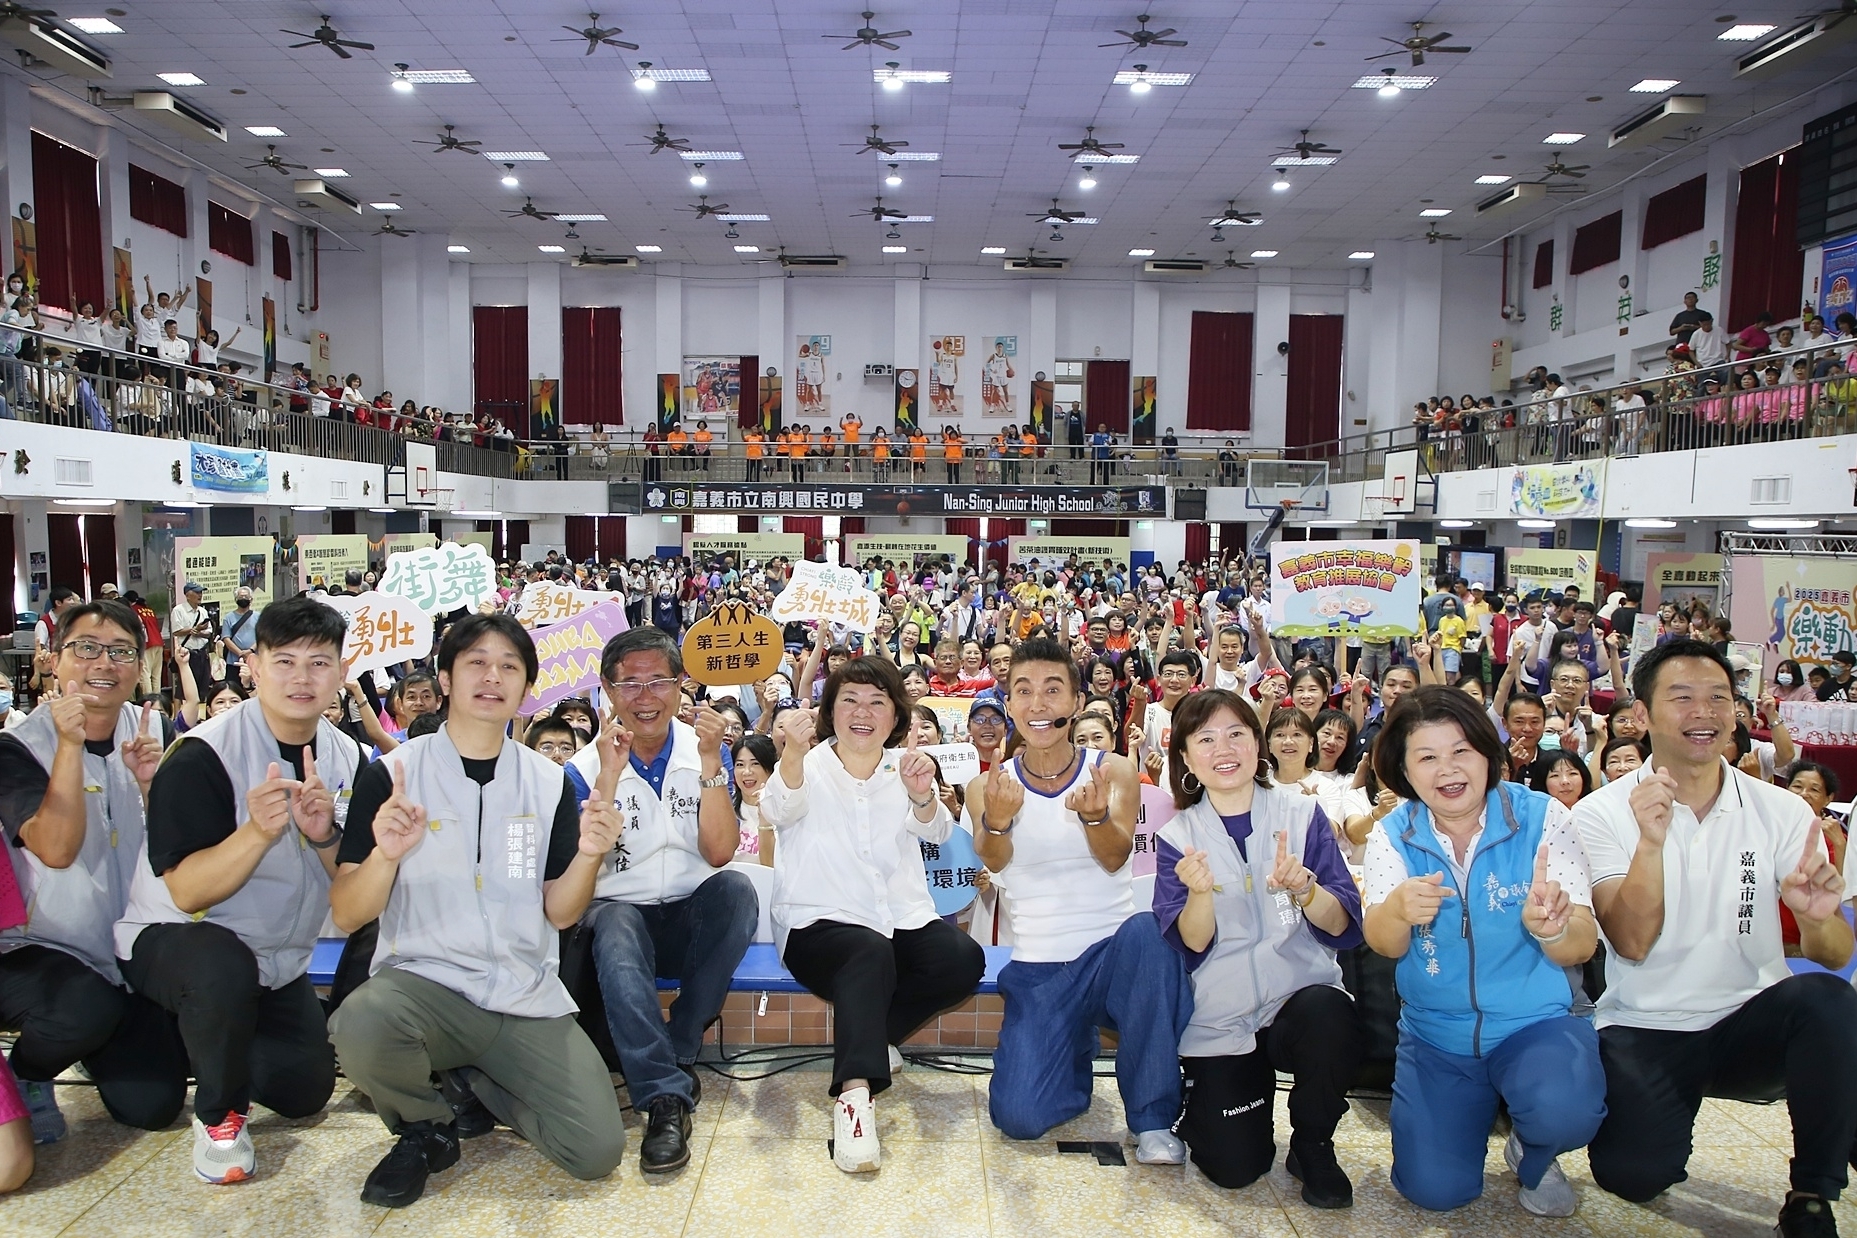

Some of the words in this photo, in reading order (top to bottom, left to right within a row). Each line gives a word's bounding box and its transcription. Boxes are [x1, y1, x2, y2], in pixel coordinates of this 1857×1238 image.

[1701, 254, 1721, 288] 聚
[692, 491, 863, 509] 嘉義市立南興國民中學
[995, 494, 1029, 511] Junior
[1031, 494, 1055, 514] High
[1058, 494, 1094, 512] School
[386, 550, 488, 610] 街舞
[1278, 550, 1413, 579] 嘉義市幸福樂齡
[1662, 570, 1720, 582] 全嘉動起來
[819, 568, 855, 595] 樂齡
[1294, 568, 1397, 593] 教育推展協會
[779, 582, 870, 626] 勇壯城
[346, 605, 415, 665] 勇壯
[536, 621, 605, 664] Danc
[697, 631, 769, 650] 第三人生
[706, 653, 760, 671] 新哲學
[626, 795, 640, 831] 議員
[507, 823, 524, 879] 楊張建南
[1483, 872, 1505, 913] 嘉義
[1738, 851, 1756, 935] 嘉義市議員
[1222, 1104, 1250, 1118] Fashion
[1250, 1097, 1266, 1109] Jeans
